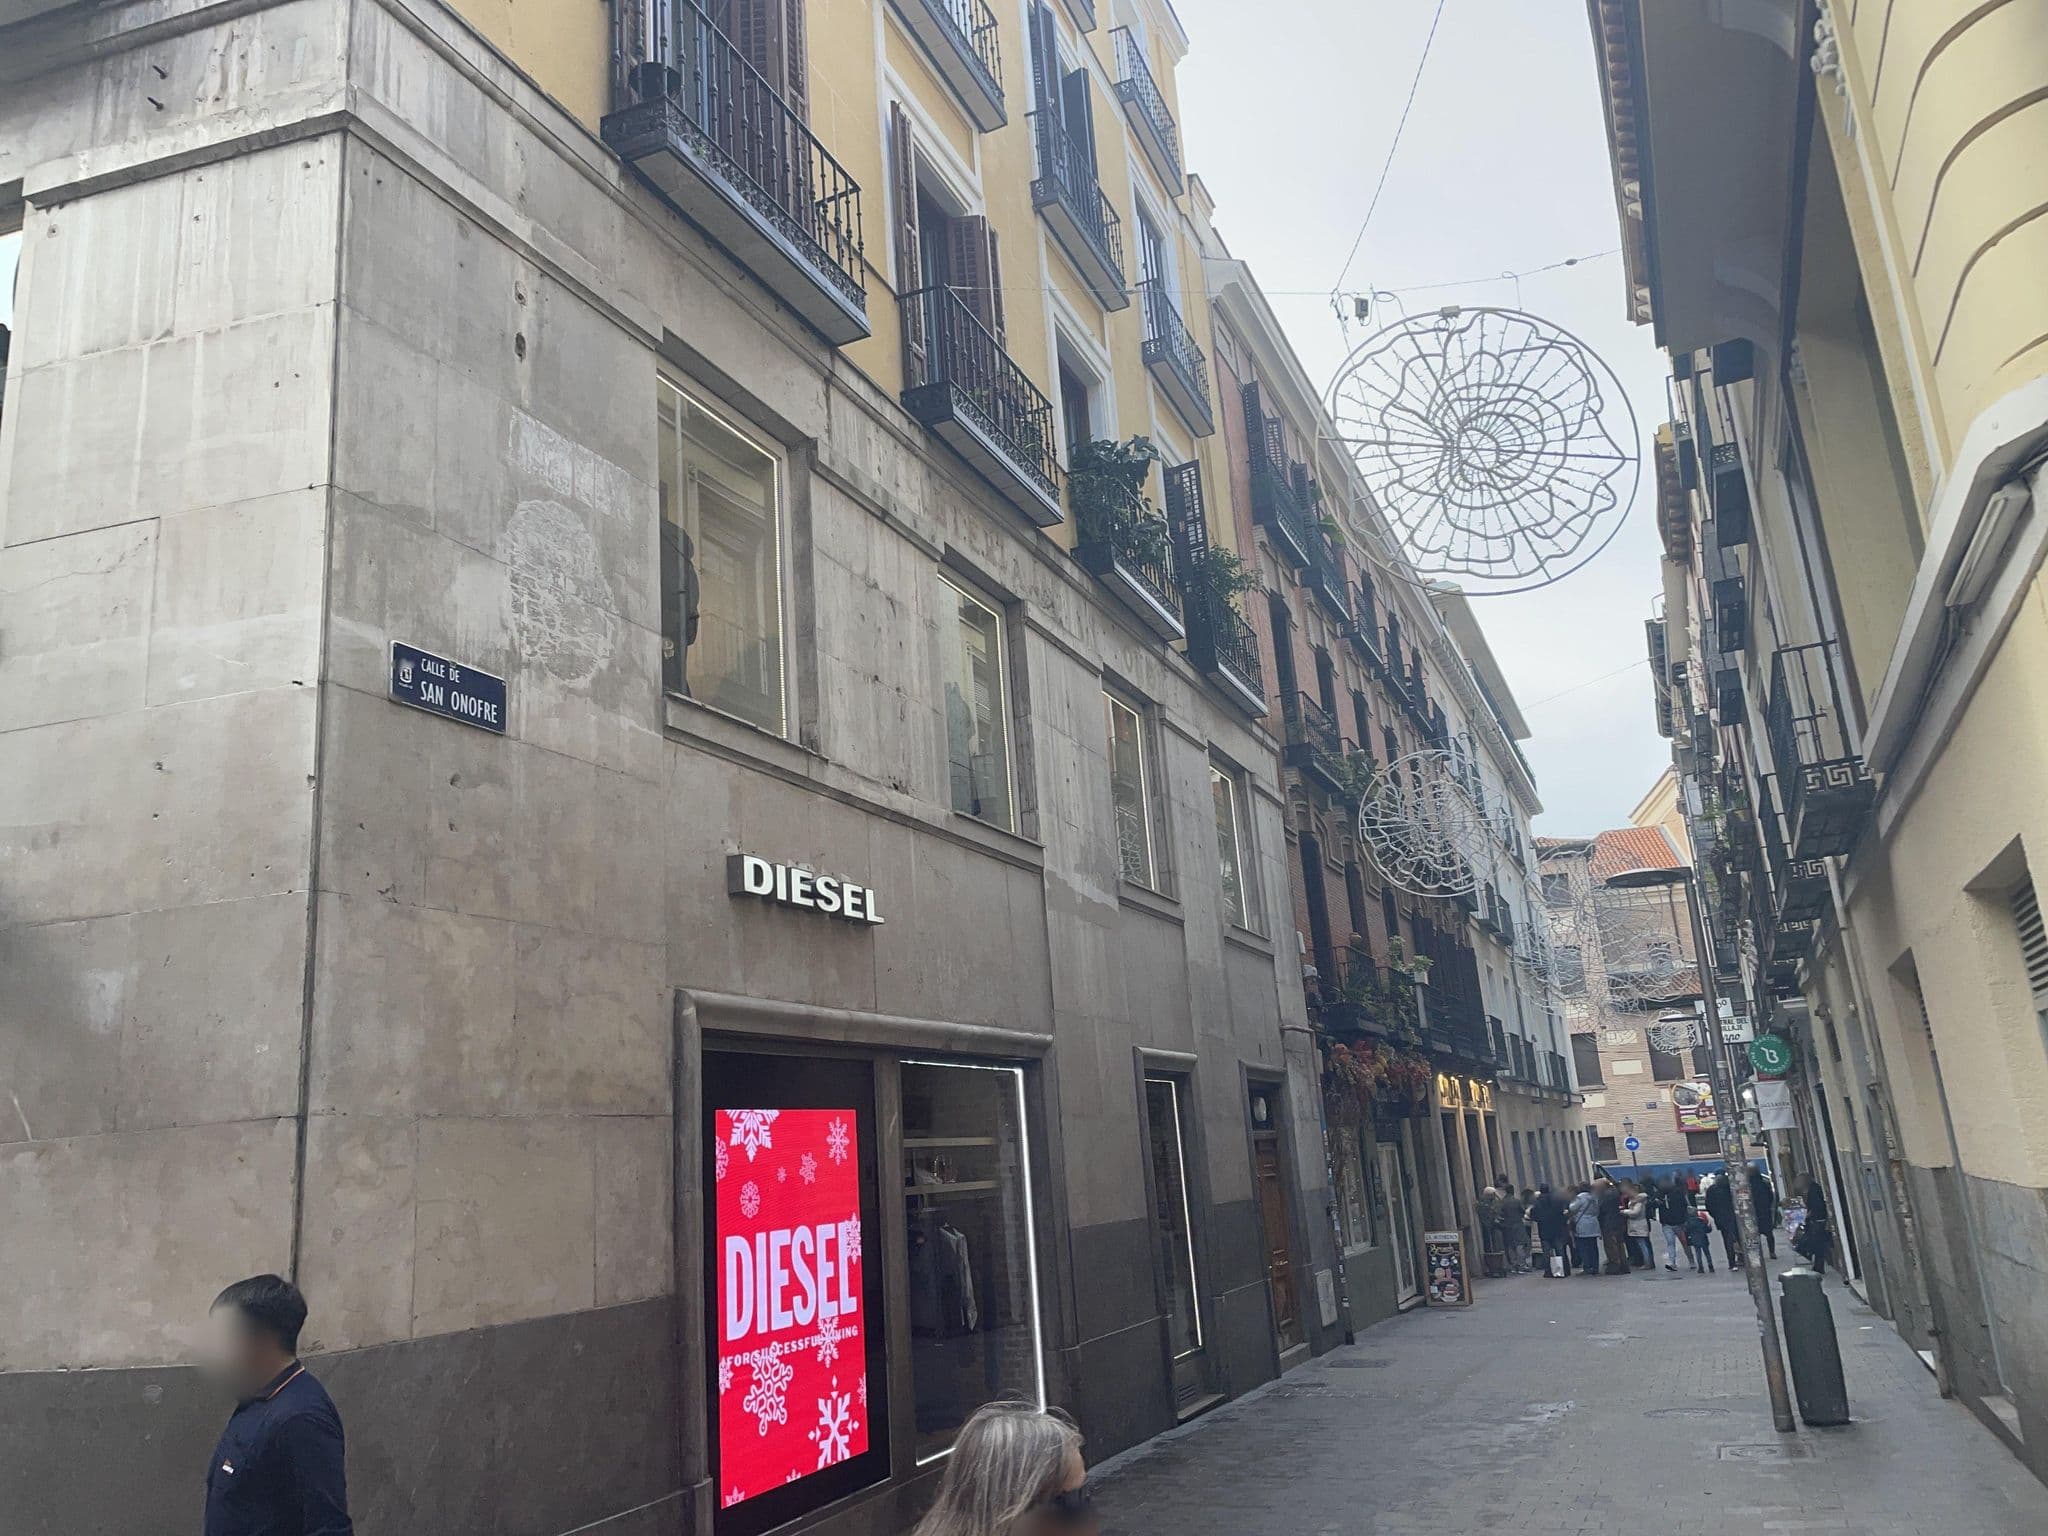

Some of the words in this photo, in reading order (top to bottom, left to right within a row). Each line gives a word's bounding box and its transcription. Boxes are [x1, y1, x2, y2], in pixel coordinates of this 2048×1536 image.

[421, 658, 445, 679] CALLE
[449, 668, 460, 683] DE
[420, 681, 444, 706] SAN
[451, 691, 498, 724] ONOFRE
[743, 854, 885, 924] DIESEL
[725, 1221, 857, 1342] DIESEL
[727, 1351, 750, 1367] FOR
